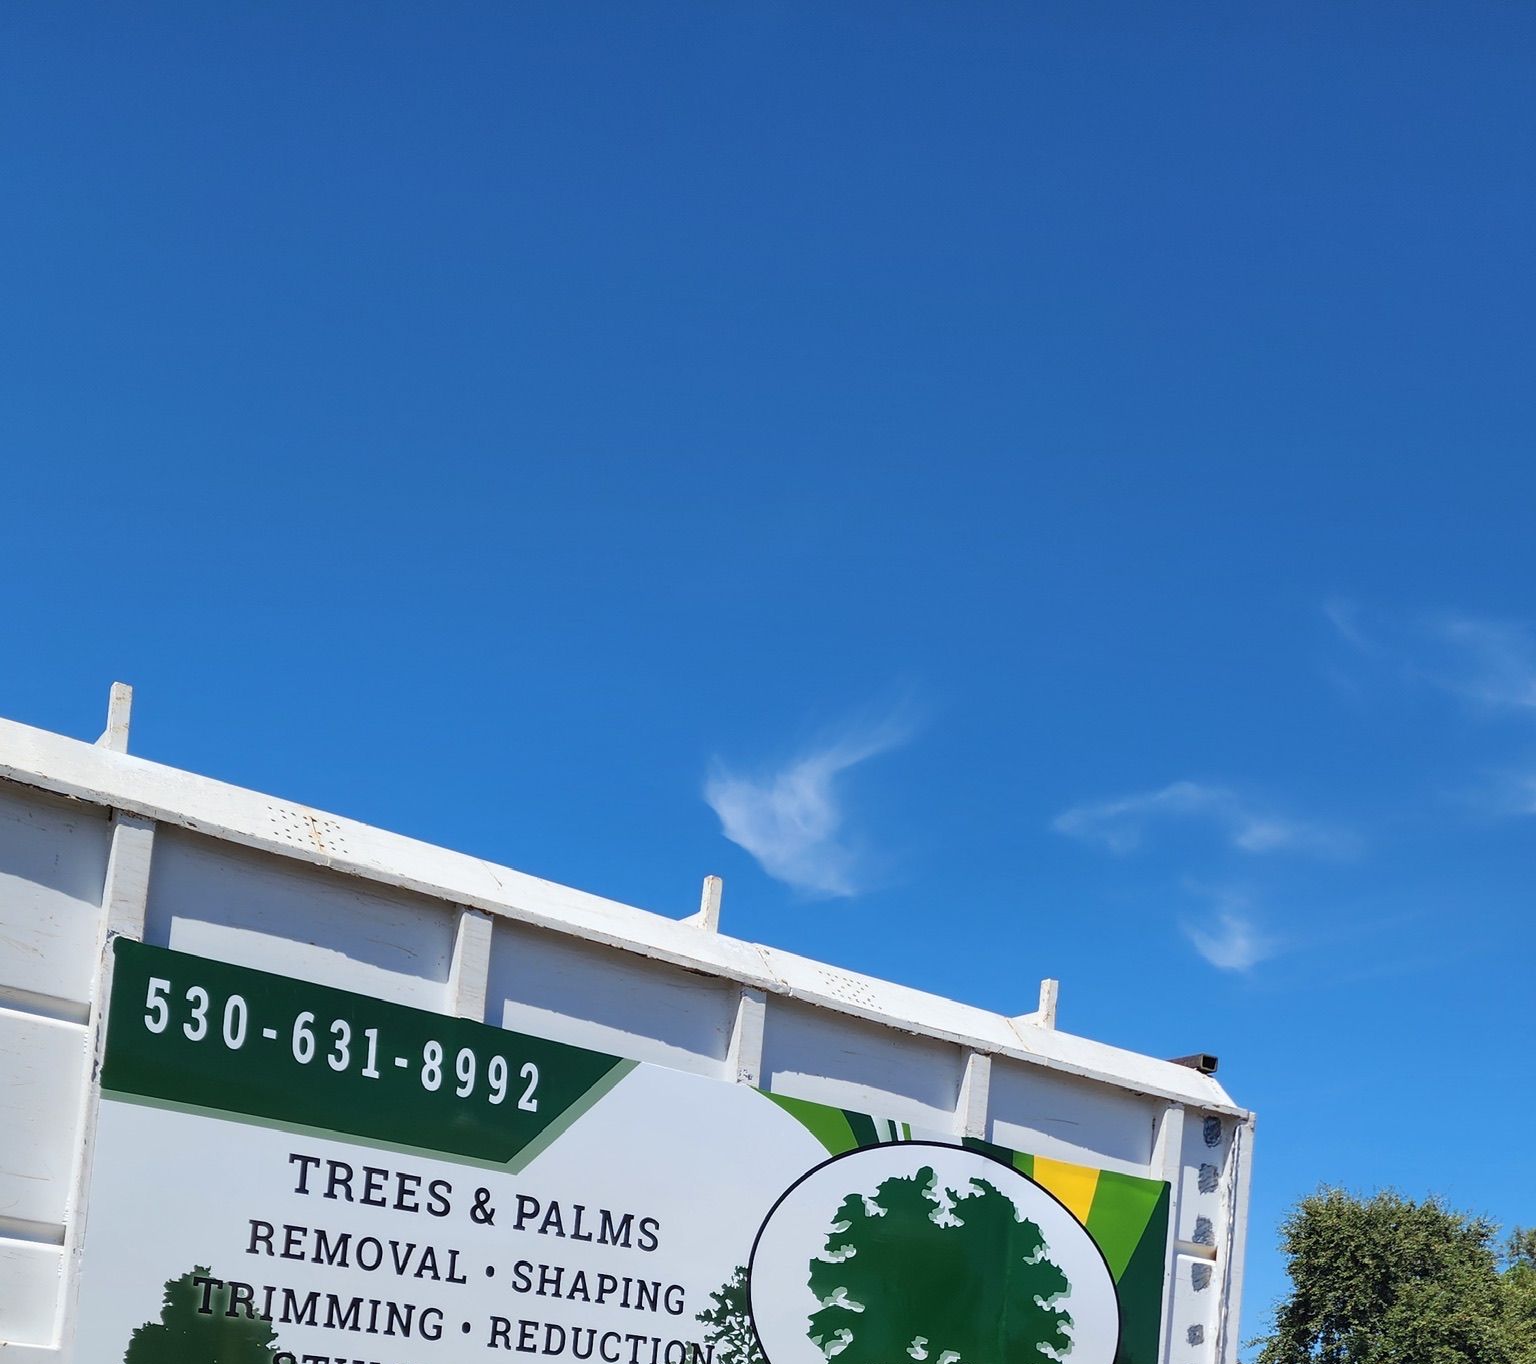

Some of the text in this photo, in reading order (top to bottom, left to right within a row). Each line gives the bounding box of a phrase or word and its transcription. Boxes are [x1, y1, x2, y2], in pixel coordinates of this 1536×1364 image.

[144, 976, 539, 1113] 530-631-8992
[289, 1153, 660, 1252] TREES & PALMS
[193, 1276, 444, 1341] TRIMMING
[246, 1220, 686, 1316] REMOVAL SHAPING
